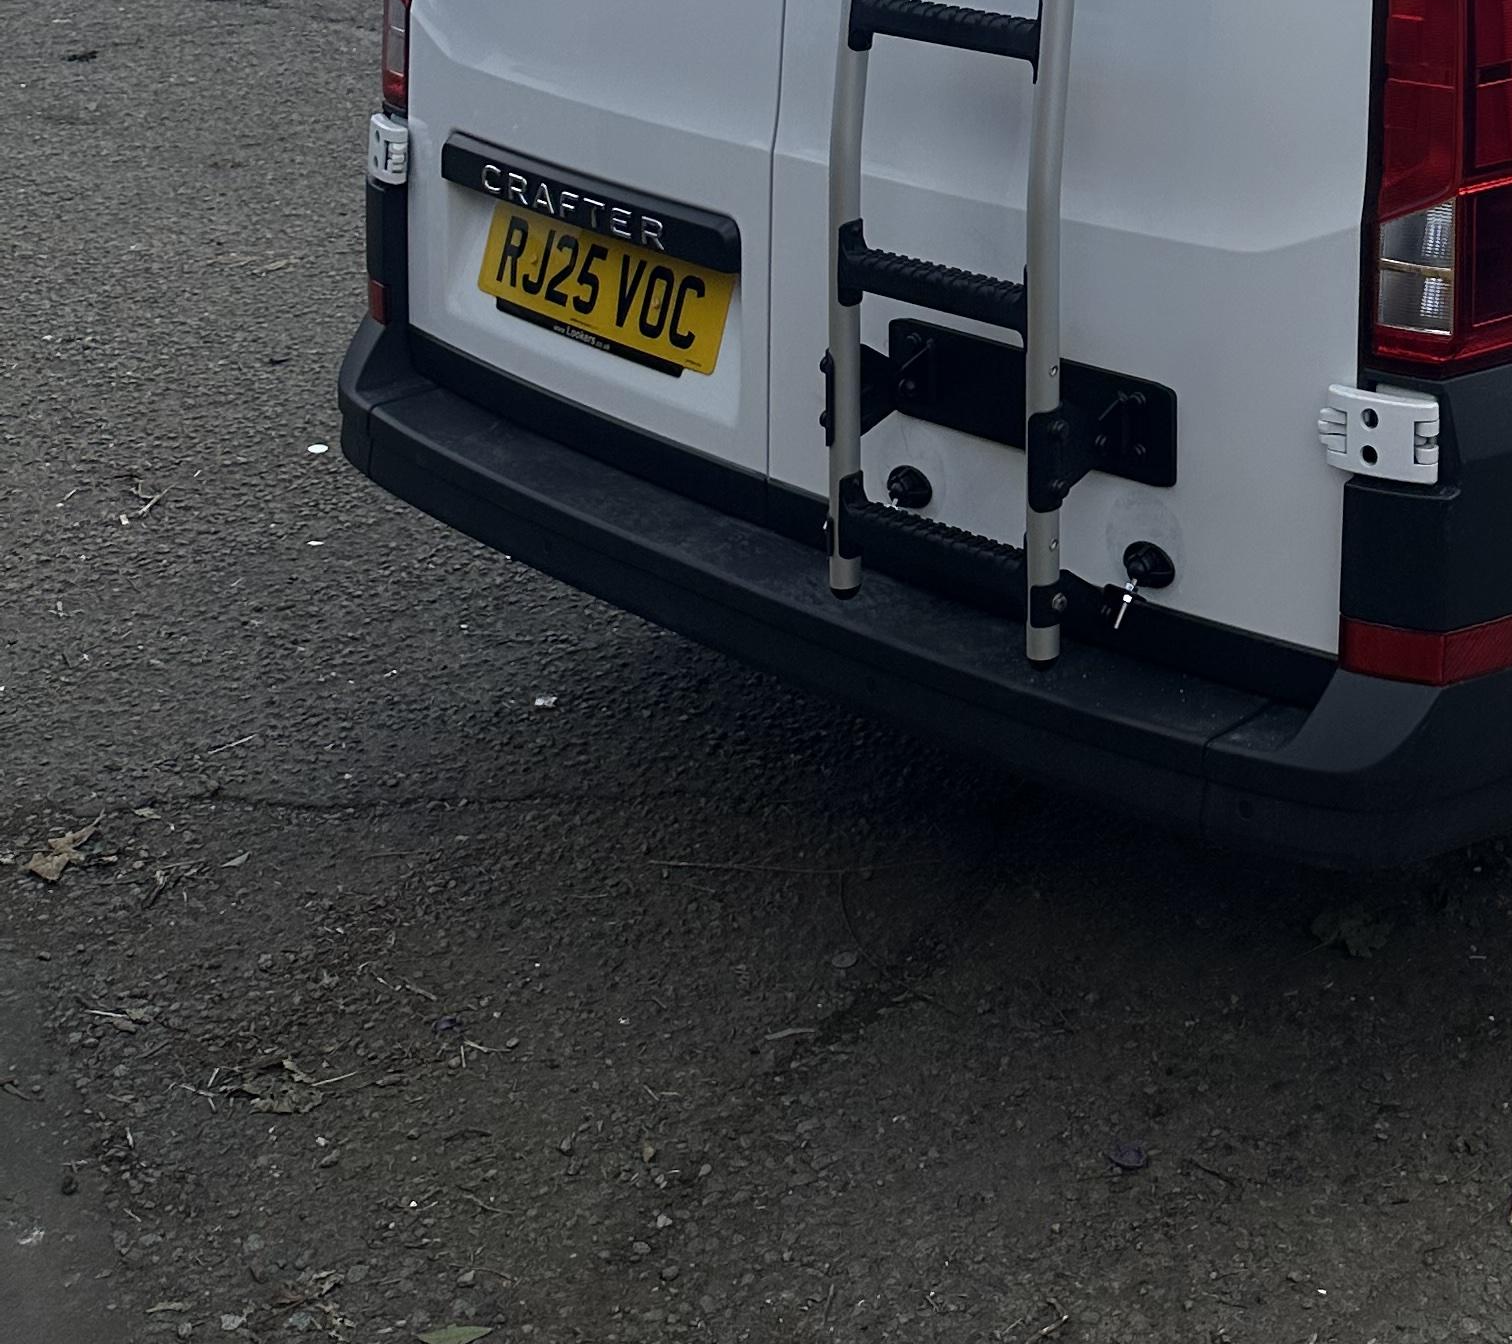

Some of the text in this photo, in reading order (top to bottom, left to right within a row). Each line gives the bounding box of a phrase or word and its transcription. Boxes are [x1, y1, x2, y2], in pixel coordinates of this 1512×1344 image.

[481, 164, 665, 251] CRAFTER
[496, 215, 706, 350] RJ25 VOC
